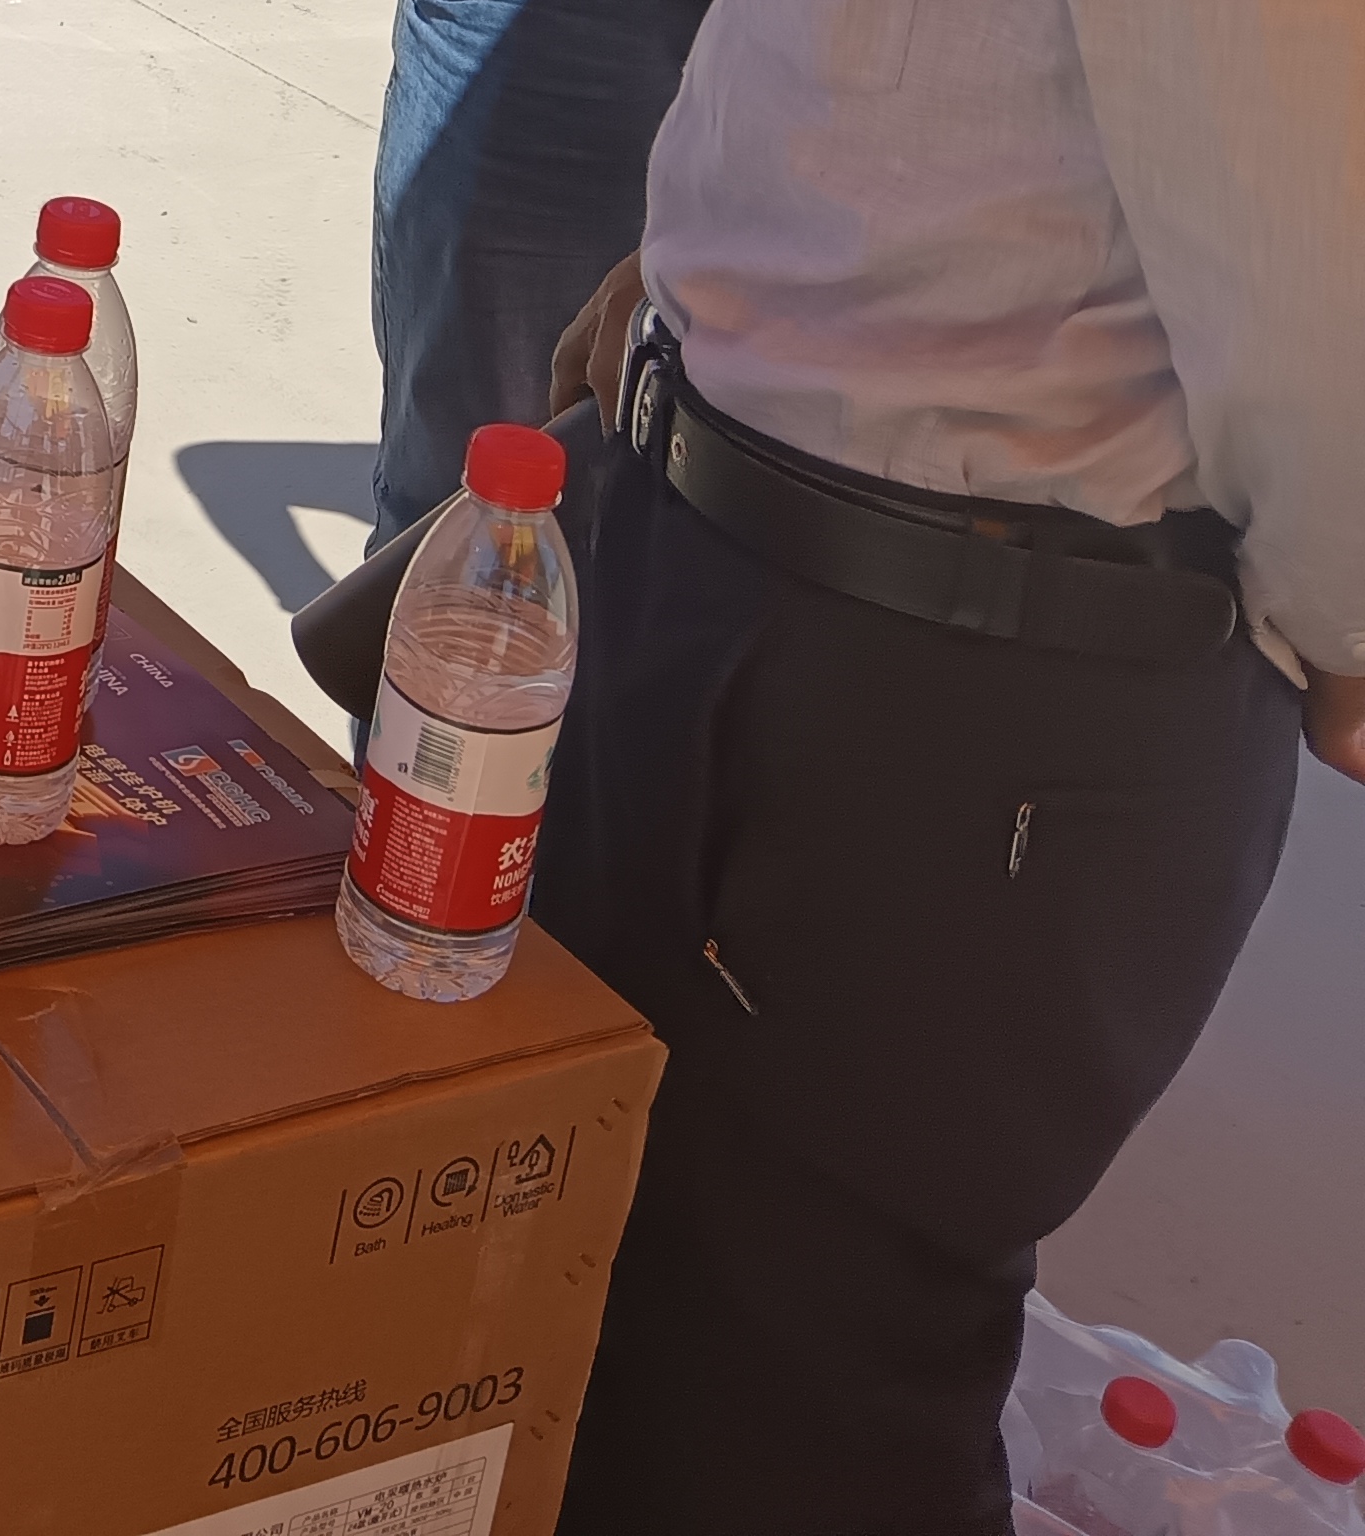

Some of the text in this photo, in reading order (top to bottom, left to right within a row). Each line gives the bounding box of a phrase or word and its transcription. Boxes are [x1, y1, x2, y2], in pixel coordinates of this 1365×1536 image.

[130, 652, 174, 688] CHINA
[205, 770, 272, 825] CGHC
[420, 1211, 475, 1239] Heating
[501, 1195, 544, 1219] Water
[353, 1236, 388, 1257] Bath
[207, 1366, 525, 1491] 400-606-9003
[216, 1379, 369, 1444] 全国服务热线
